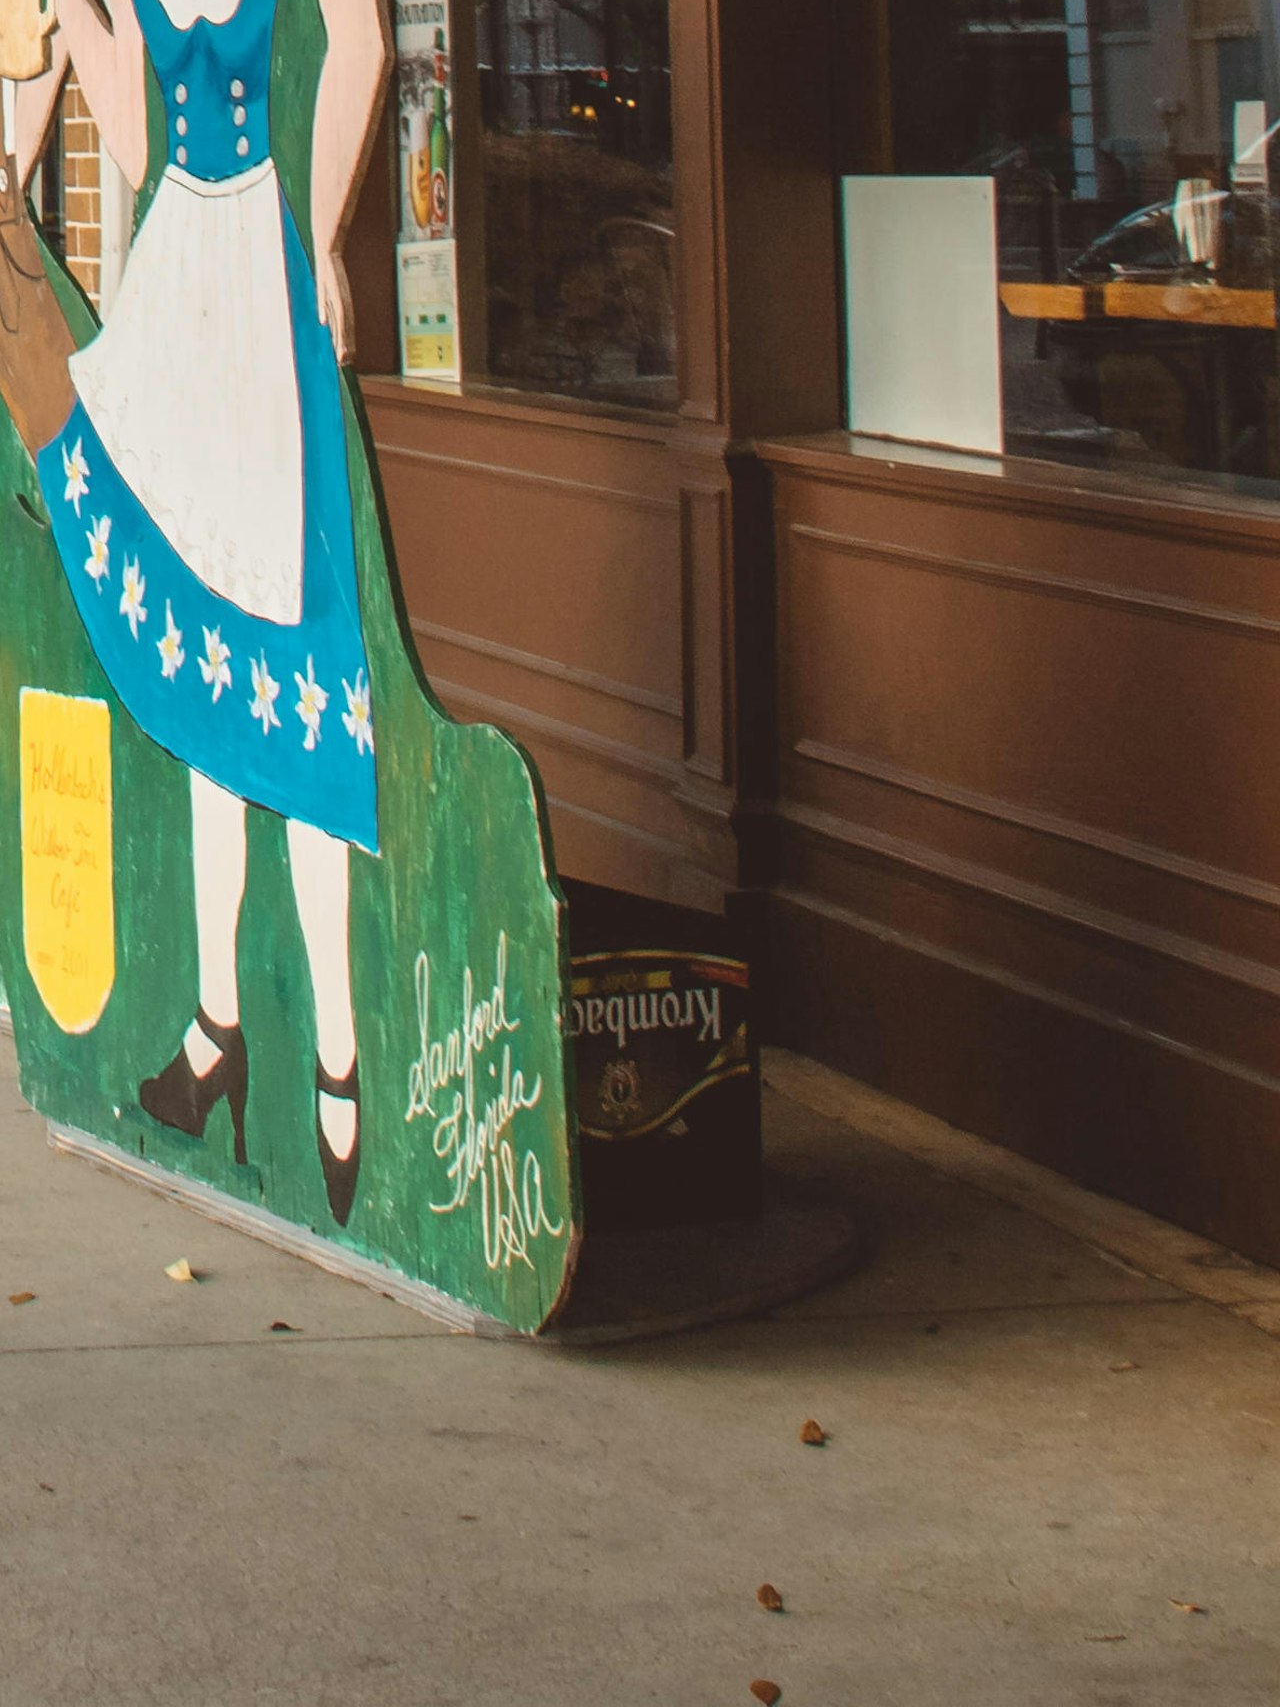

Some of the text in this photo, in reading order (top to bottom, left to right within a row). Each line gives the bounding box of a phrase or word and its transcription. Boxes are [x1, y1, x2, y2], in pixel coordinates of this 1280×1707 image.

[404, 929, 521, 1123] Sanford
[567, 987, 722, 1049] Krombac
[429, 1044, 542, 1213] Florida
[480, 1148, 563, 1271] USA
